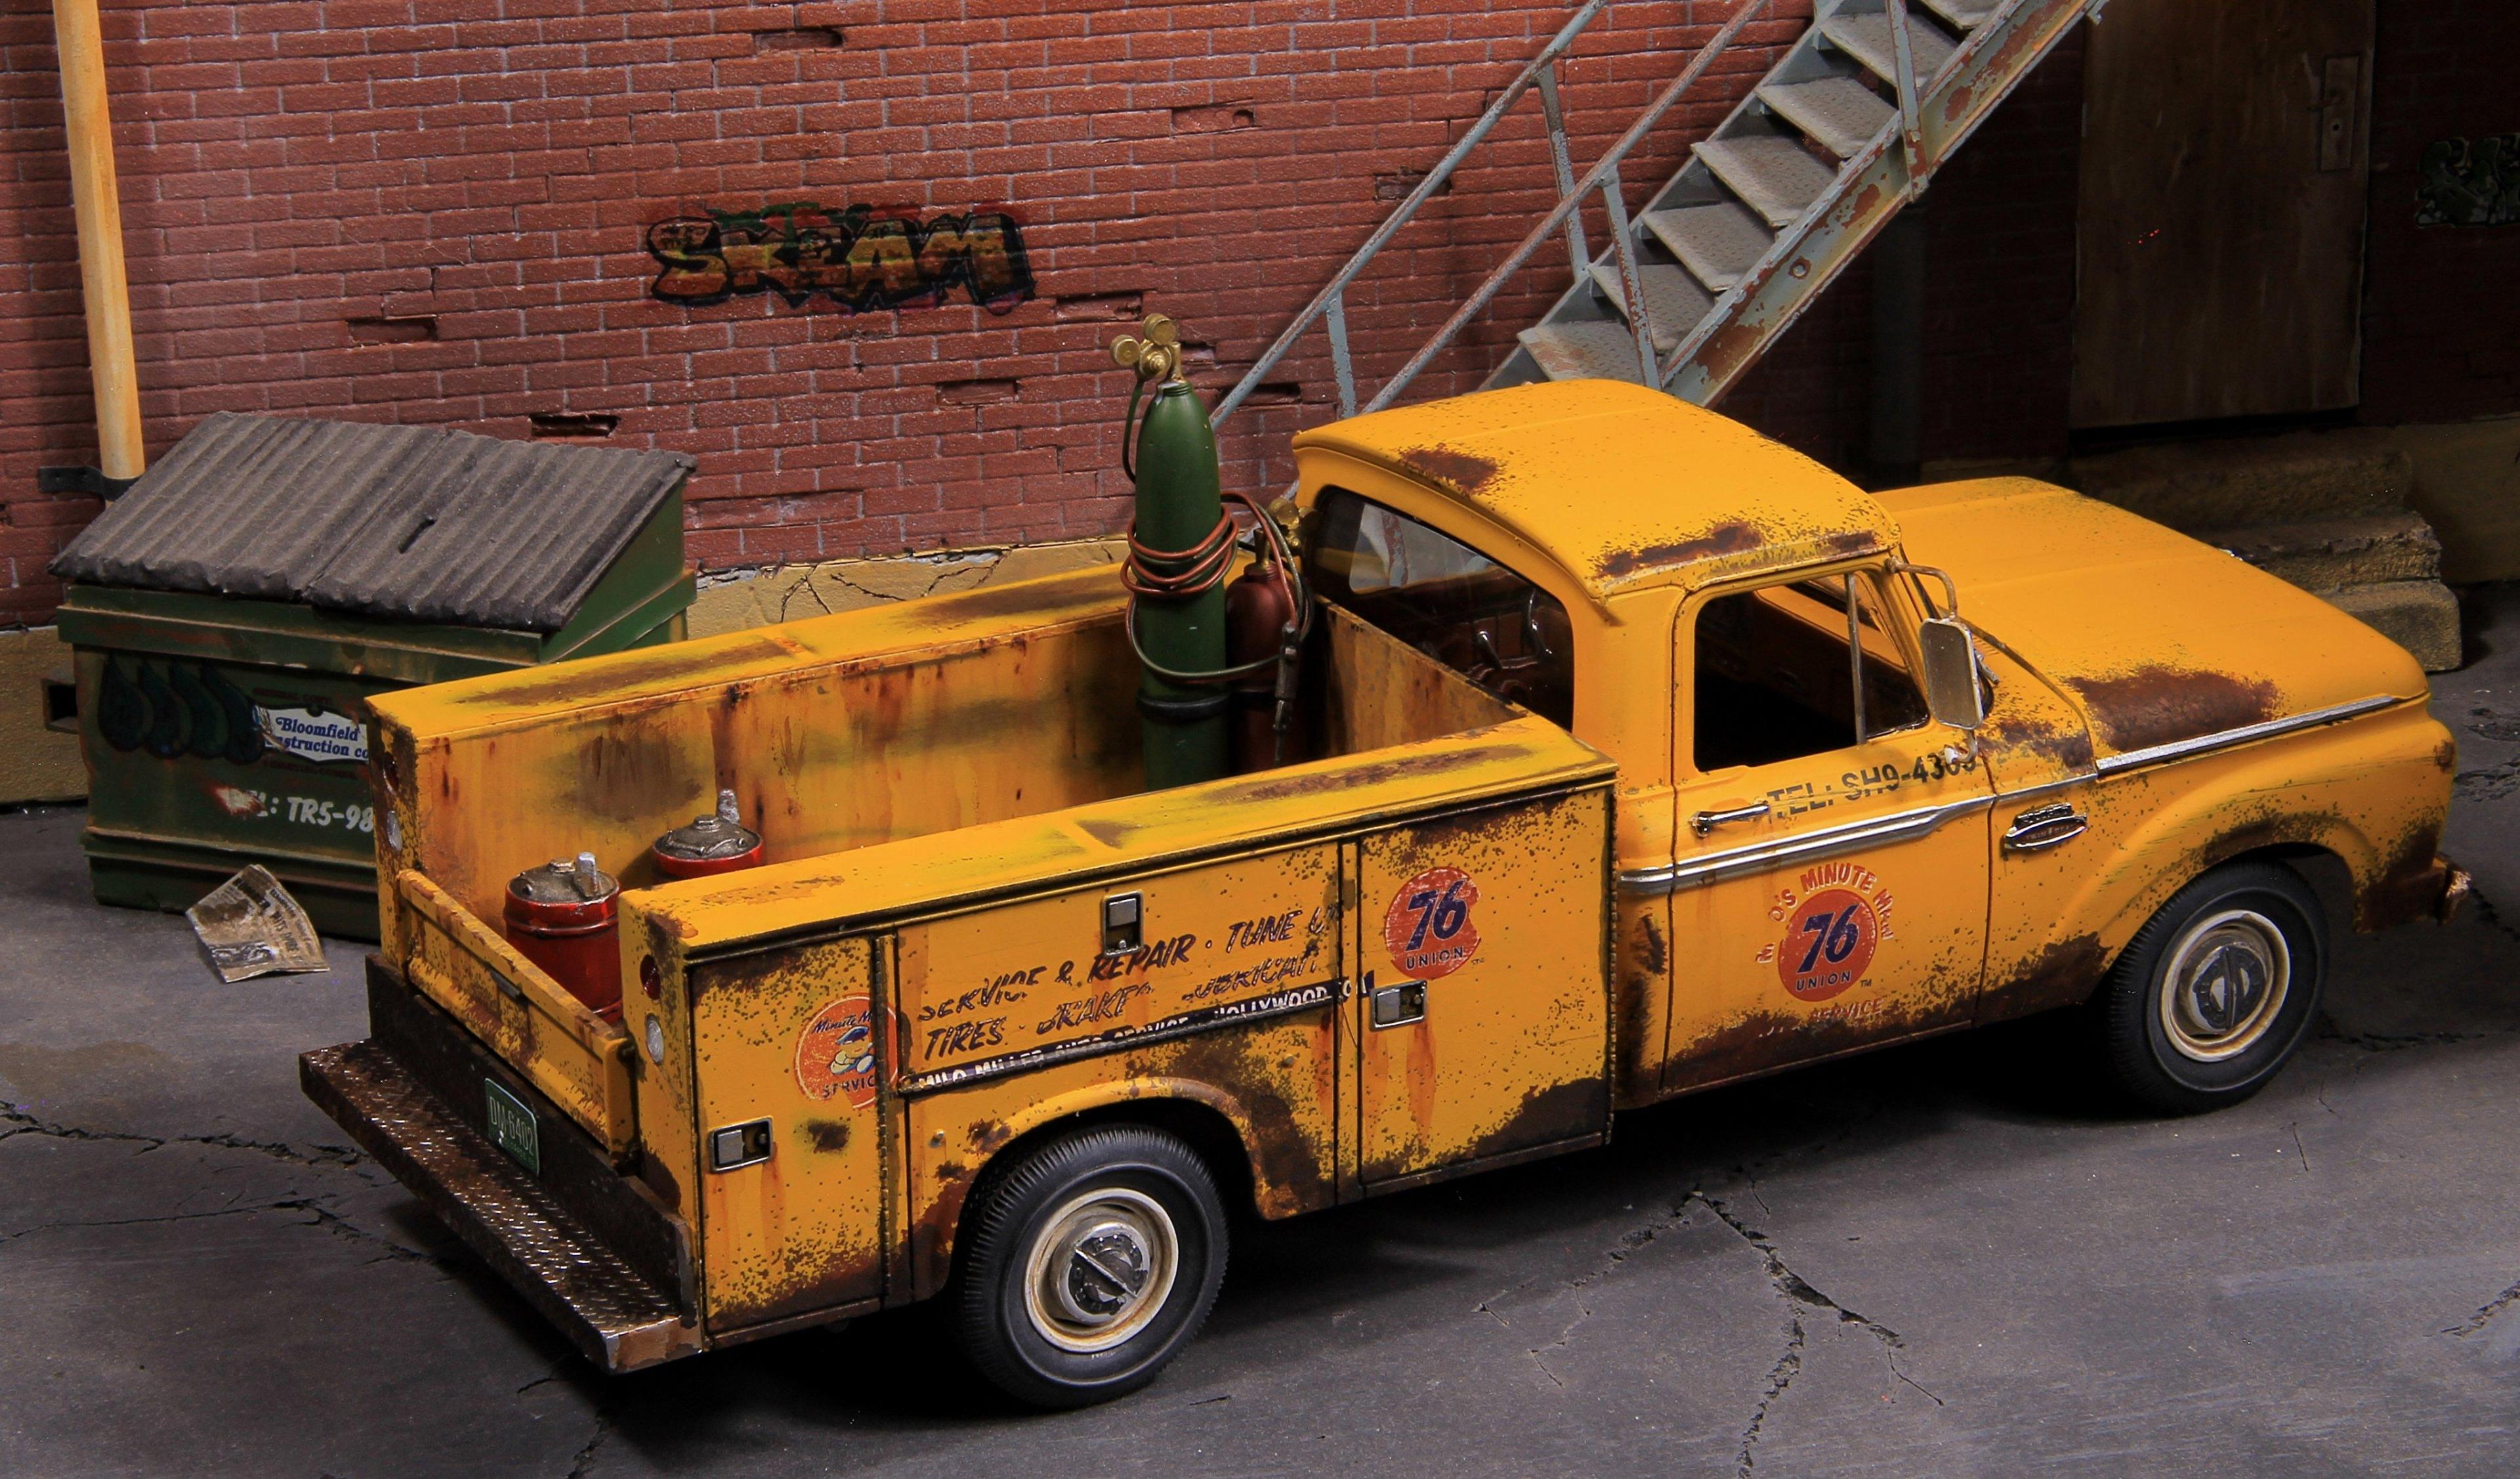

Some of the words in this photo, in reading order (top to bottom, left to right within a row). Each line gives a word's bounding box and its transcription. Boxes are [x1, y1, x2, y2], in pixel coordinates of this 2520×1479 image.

[276, 716, 360, 742] Bloomfield
[1800, 862, 1878, 895] MINUTE
[1404, 878, 1469, 952] 76
[1055, 960, 1075, 985] &
[1087, 933, 1196, 983] REPAIR
[1226, 910, 1303, 953] TUNE
[1796, 903, 1860, 973] 76
[1406, 946, 1465, 971] UNION
[1796, 970, 1852, 992] UNION
[924, 1016, 1007, 1061] TIRES
[822, 1075, 877, 1099] SERVIC
